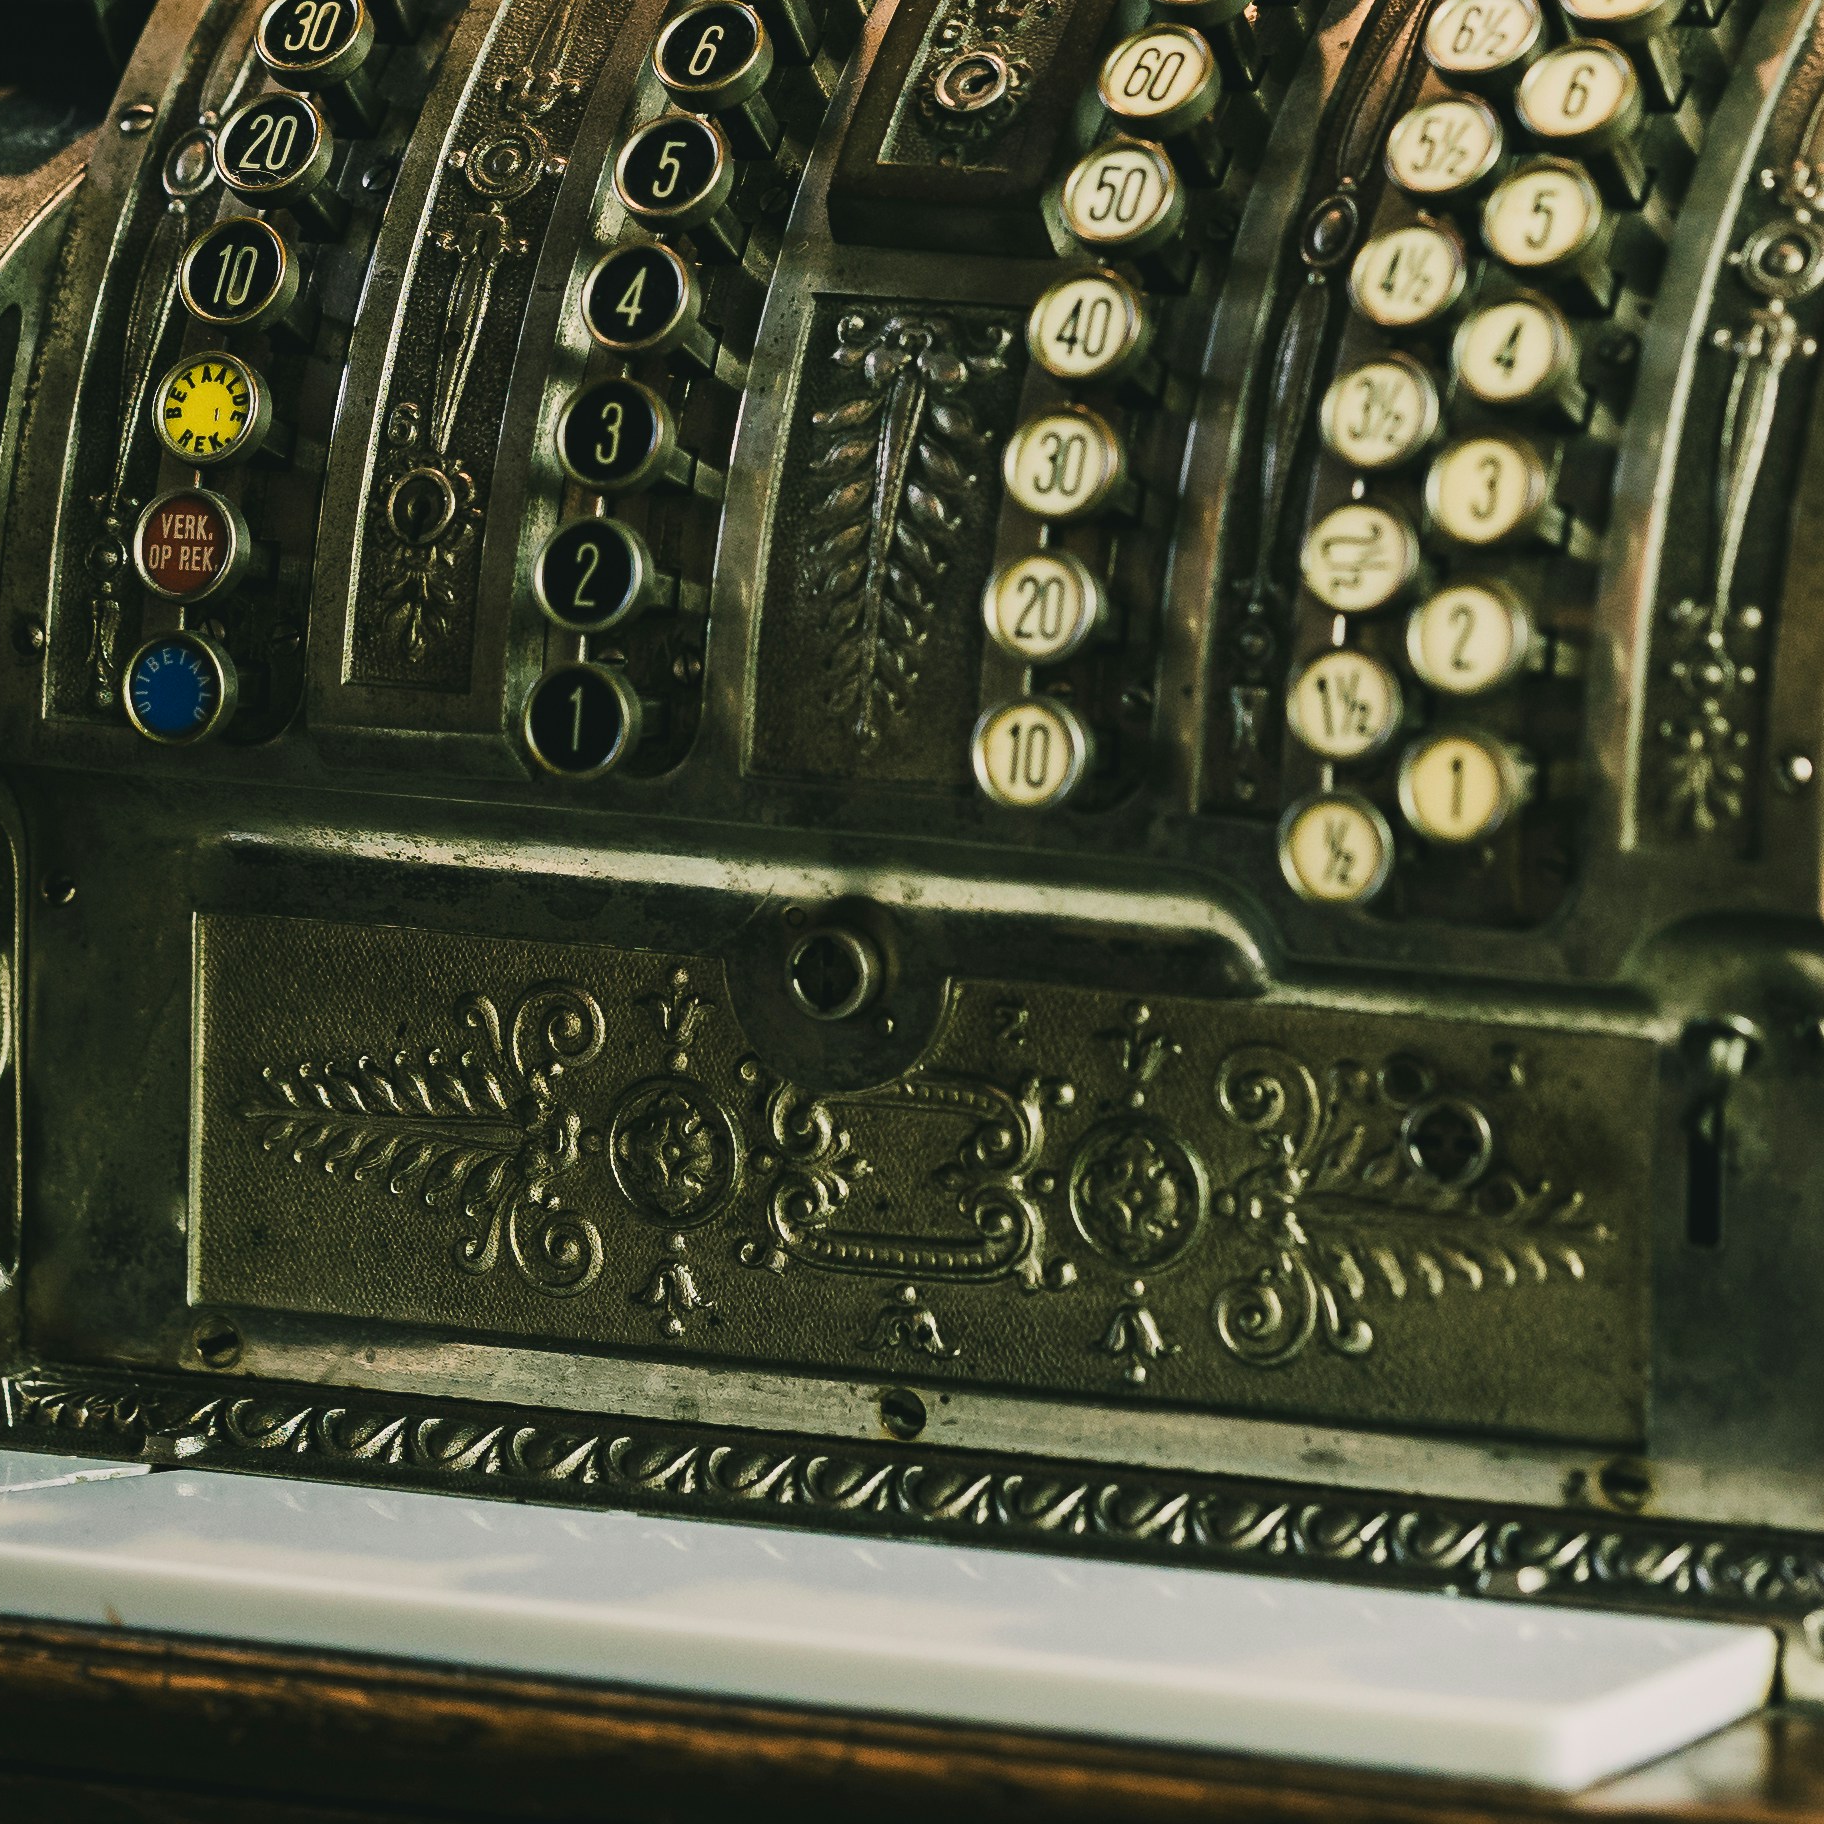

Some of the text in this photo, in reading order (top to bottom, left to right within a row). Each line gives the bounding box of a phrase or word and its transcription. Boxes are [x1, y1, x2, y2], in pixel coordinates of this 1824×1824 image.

[287, 1, 341, 53] 30
[689, 26, 722, 76] 6
[1124, 47, 1184, 102] 60
[1563, 67, 1591, 116] 6
[241, 114, 296, 171] 20
[652, 140, 680, 197] 5
[1089, 164, 1147, 224] 50
[1527, 187, 1556, 246] 5
[216, 244, 255, 307] 10
[615, 267, 644, 328] 4
[1055, 295, 1114, 359] 40
[1496, 321, 1529, 379] 4
[165, 366, 250, 425] BETAALDE
[387, 402, 420, 446] 6
[177, 429, 232, 454] REK.
[595, 402, 621, 466] 3
[1033, 433, 1090, 498] 30
[1473, 456, 1502, 522] 3
[161, 513, 214, 542] VERK.
[149, 544, 218, 573] OP REK.
[573, 543, 598, 607] 2
[1013, 578, 1067, 642] 20
[1451, 603, 1476, 673] 2
[134, 647, 213, 722] UITBETAALD
[568, 687, 582, 750] 1
[1008, 722, 1051, 788] 10
[1450, 755, 1464, 820] 1
